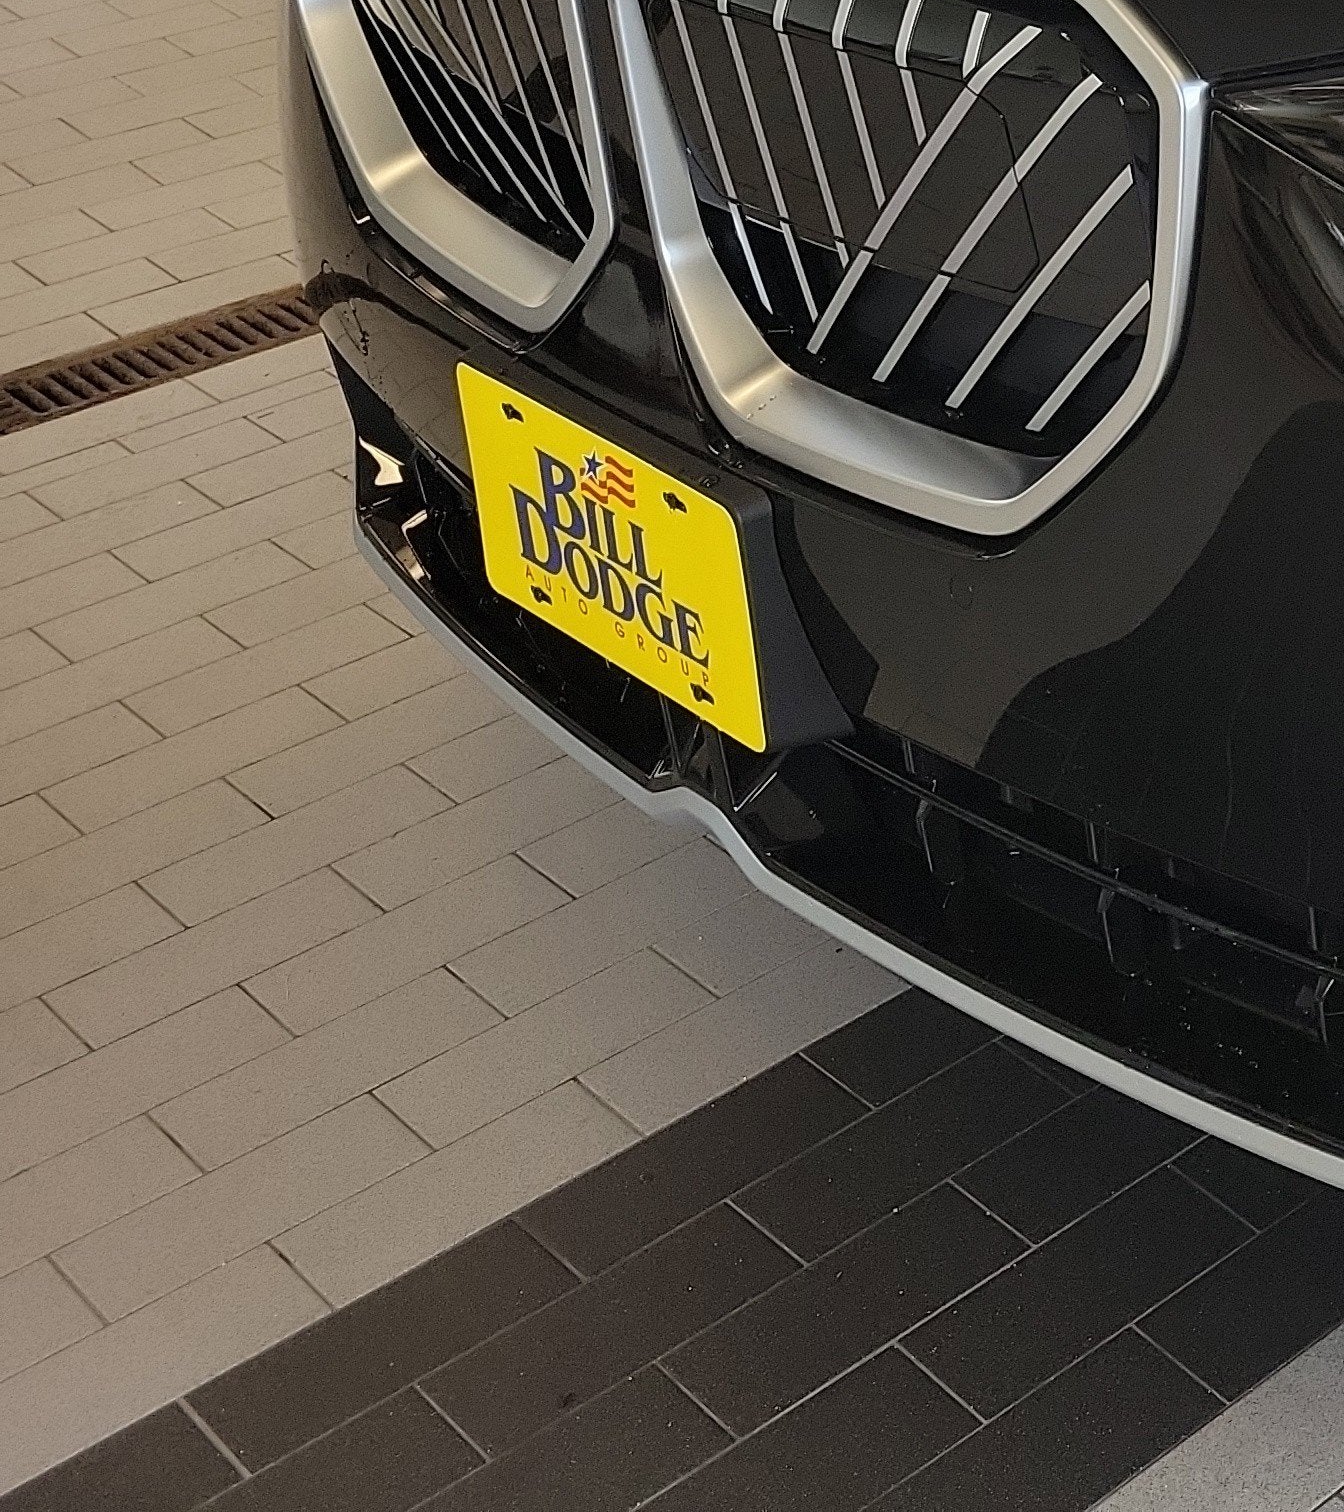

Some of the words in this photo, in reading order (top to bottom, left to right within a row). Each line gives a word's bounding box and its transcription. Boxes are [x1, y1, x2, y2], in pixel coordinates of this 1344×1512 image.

[509, 483, 710, 669] DODGE
[534, 446, 662, 590] BILL
[524, 564, 589, 616] AUTO
[615, 620, 711, 687] GROUP
